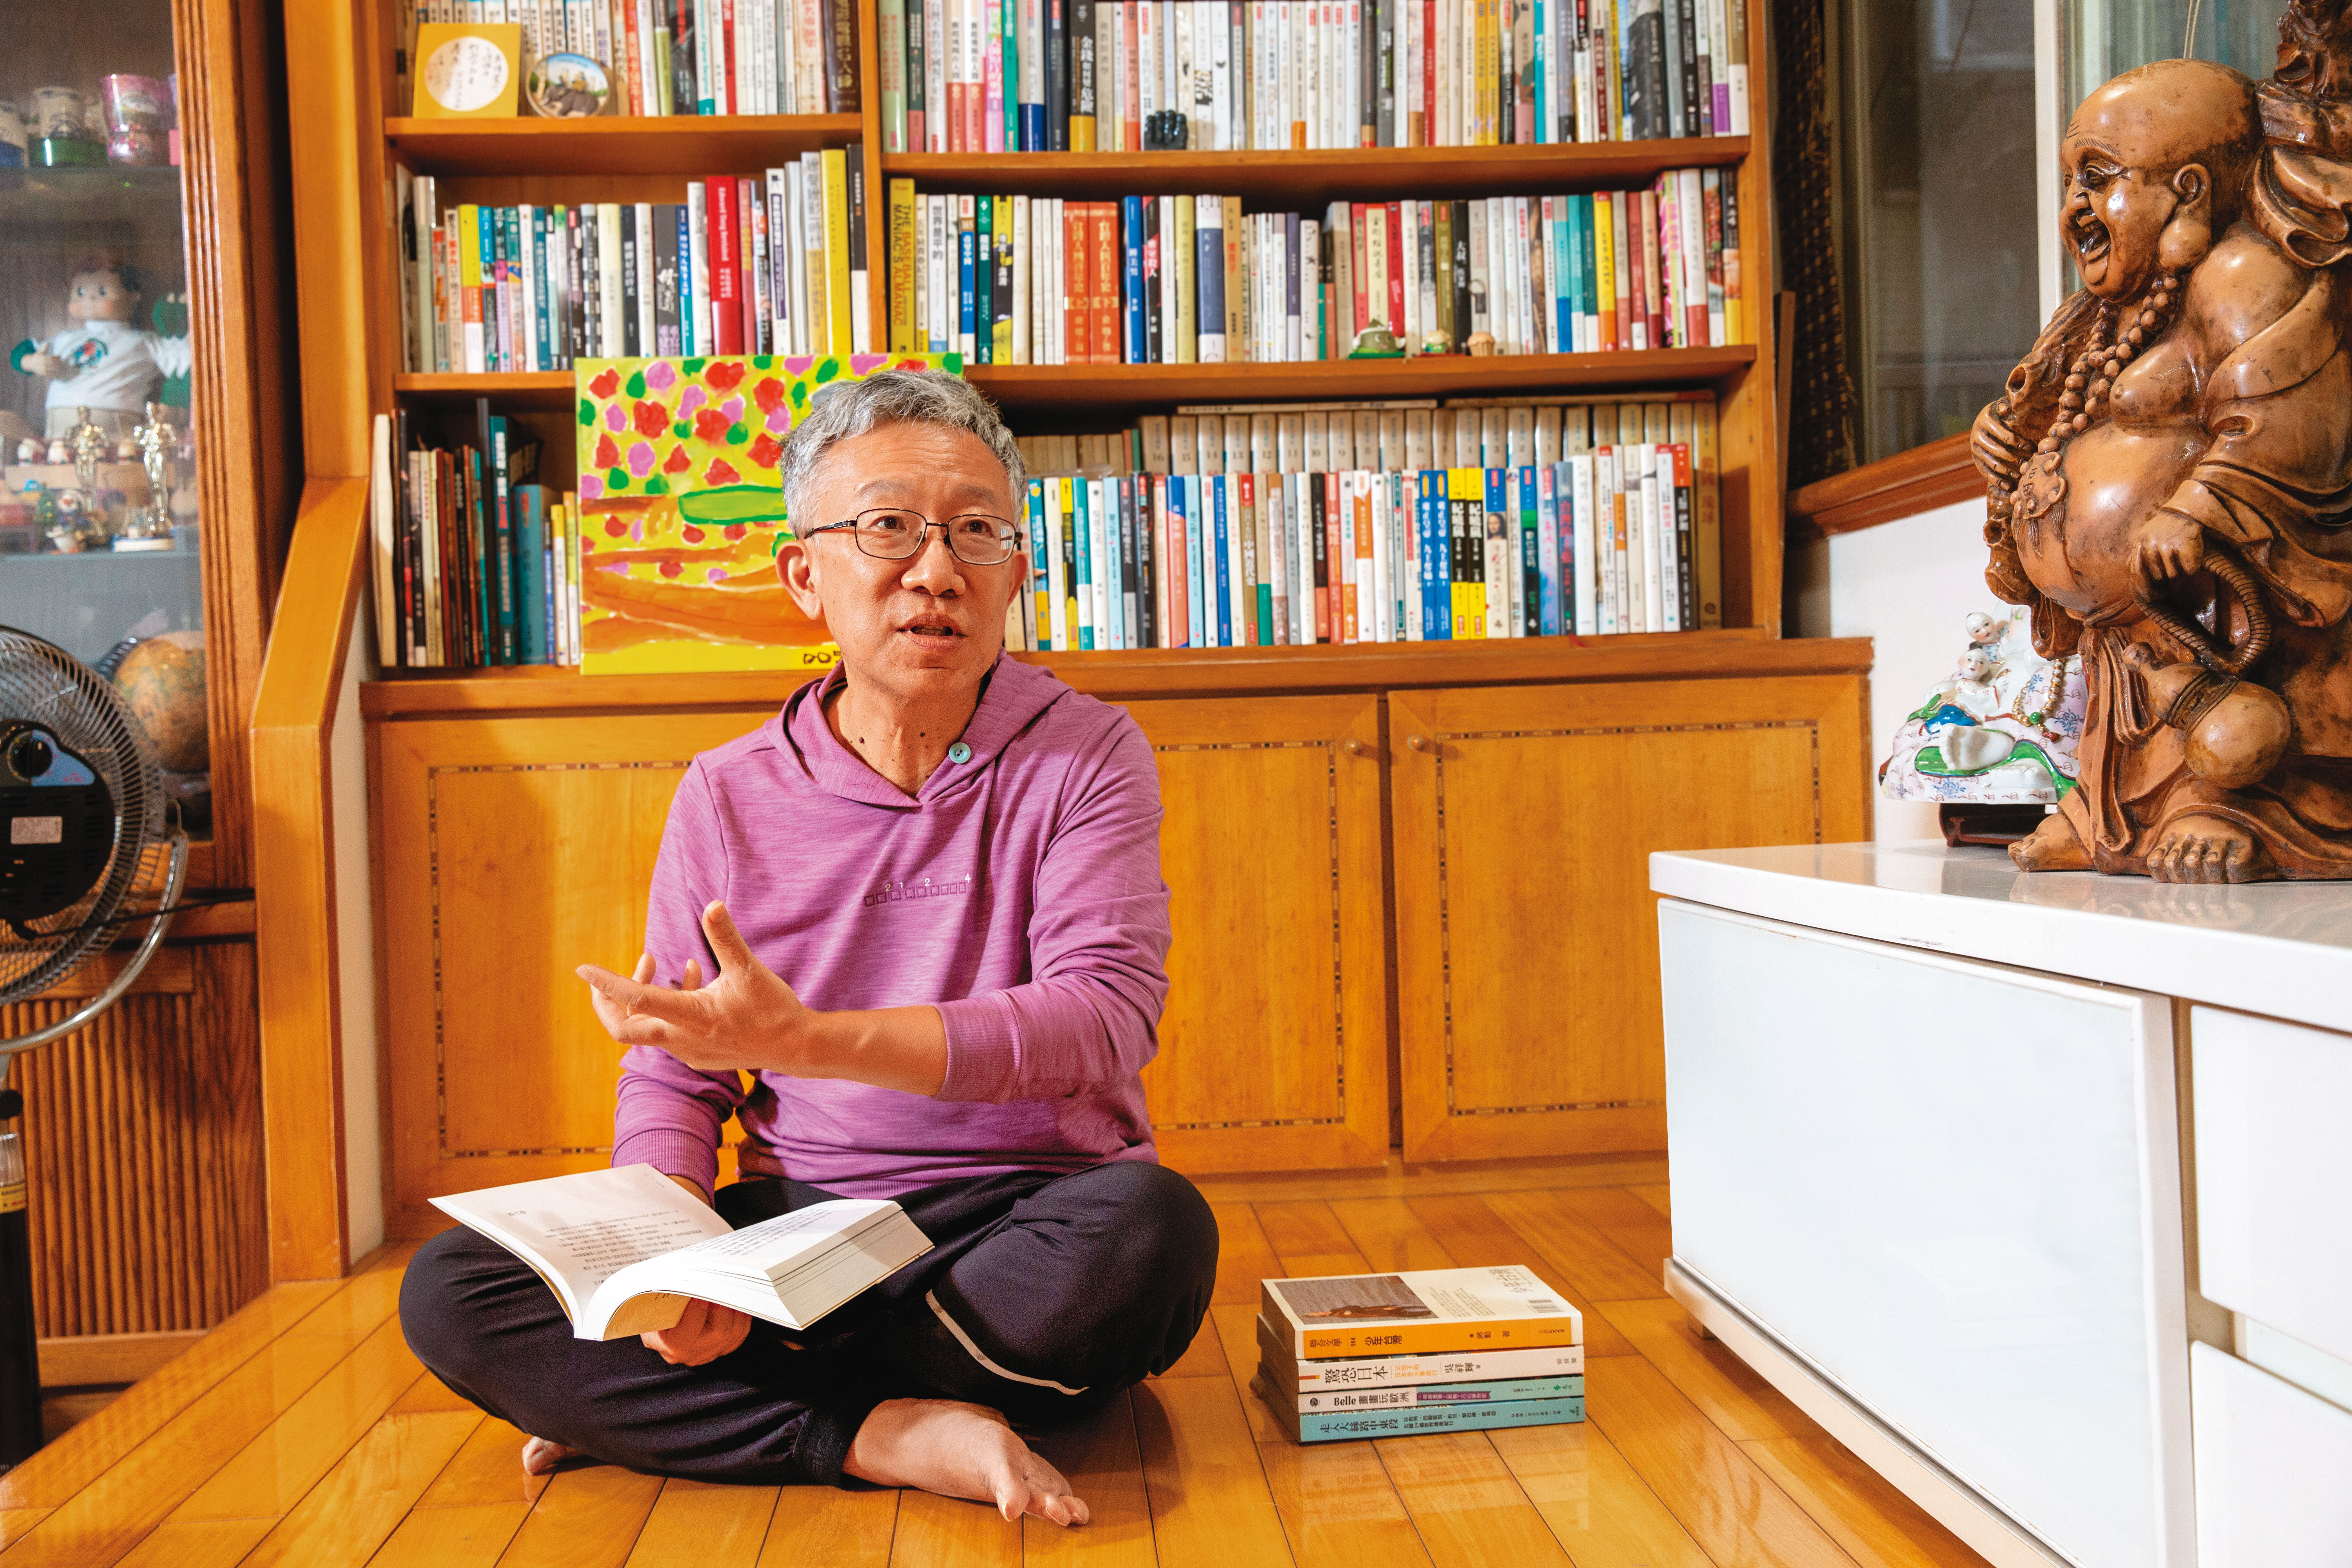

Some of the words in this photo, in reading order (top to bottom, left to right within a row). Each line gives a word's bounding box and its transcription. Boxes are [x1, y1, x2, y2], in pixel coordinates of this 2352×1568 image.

[718, 187, 726, 214] Edward
[902, 204, 912, 227] THE
[893, 204, 903, 264] MANIAC'S
[932, 205, 944, 261] 世界是平的
[902, 232, 913, 295] BASEBALL
[893, 265, 903, 327] ALMANAC
[885, 883, 891, 892] 2
[924, 878, 931, 886] 2
[964, 873, 971, 883] 4
[1310, 1338, 1343, 1348] 聯合文學
[1364, 1335, 1402, 1347] 少年台灣
[1325, 1365, 1388, 1385] 驚恐日本
[1445, 1362, 1474, 1374] 吳祥輝
[1334, 1395, 1356, 1406] Belle
[1359, 1392, 1410, 1405] 畫畫玩歐洲
[1320, 1419, 1399, 1433] 走入大絲路中東段
